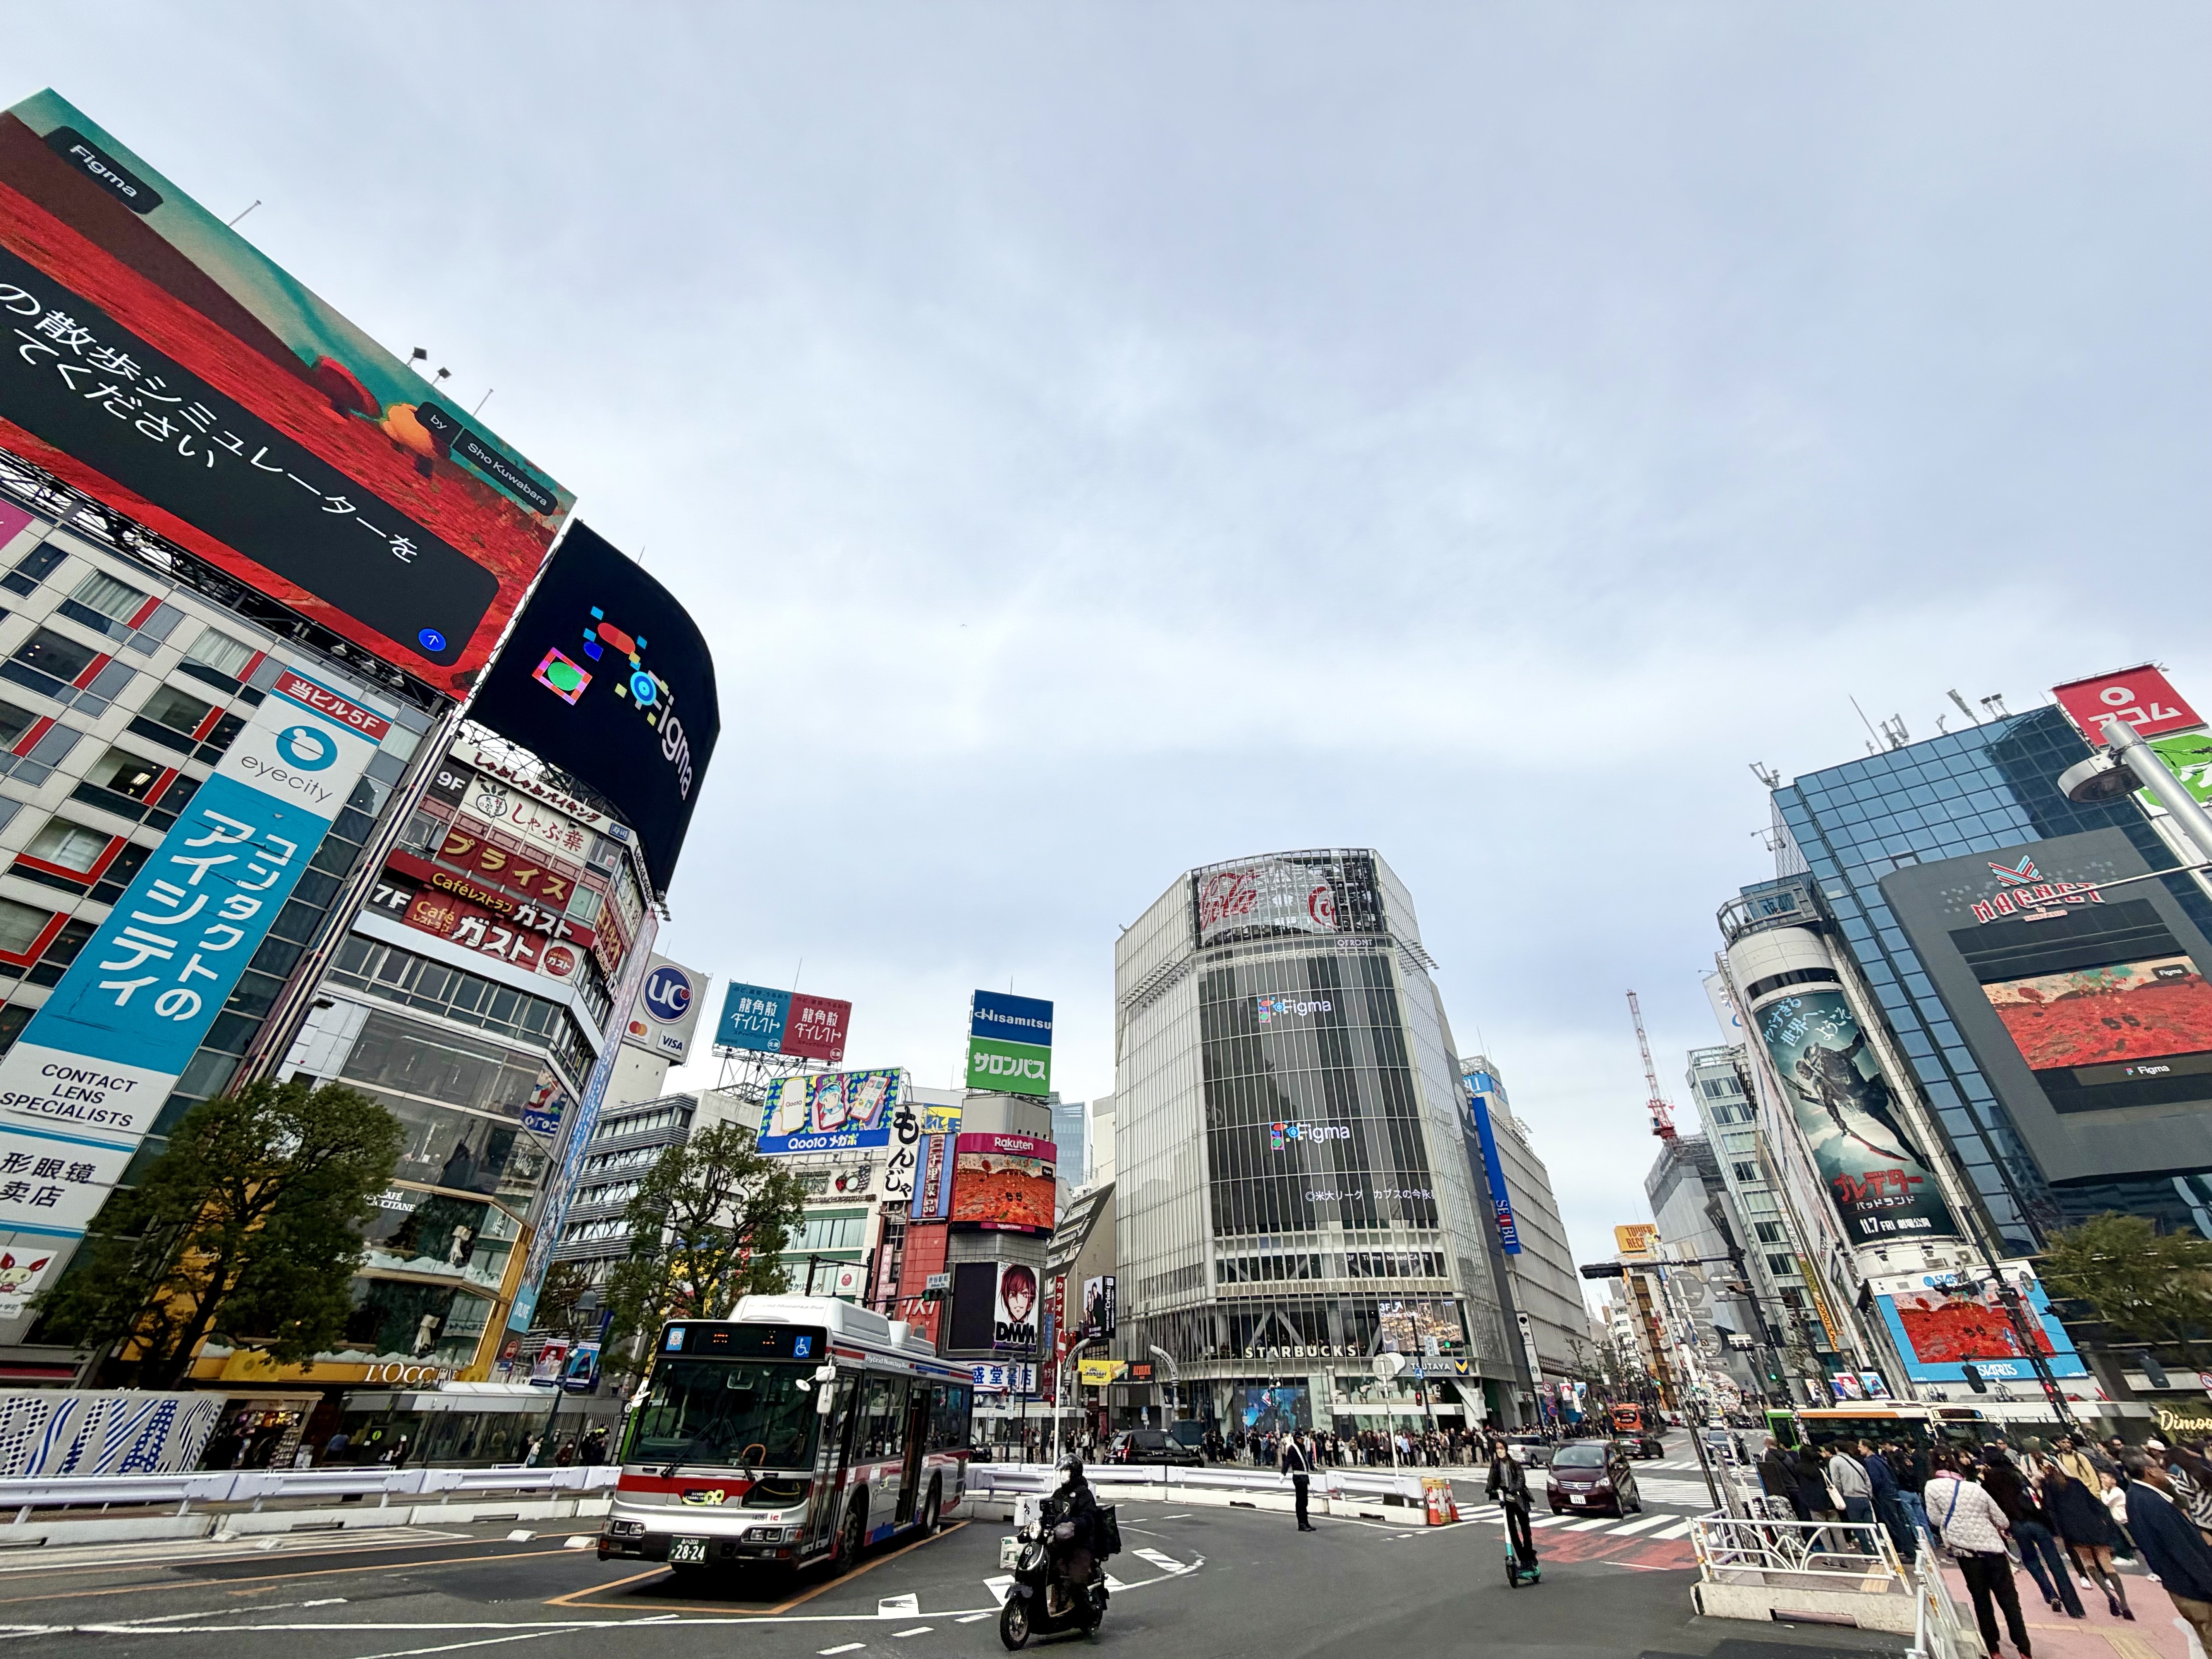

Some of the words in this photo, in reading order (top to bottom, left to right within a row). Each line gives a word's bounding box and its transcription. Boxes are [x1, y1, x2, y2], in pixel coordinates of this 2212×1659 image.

[70, 144, 137, 197] Figma
[14, 328, 214, 467] てください
[0, 283, 418, 563] の散歩シミュレーターを
[429, 414, 447, 430] by
[467, 442, 493, 465] Sho
[492, 461, 547, 507] Kuwabara
[288, 680, 380, 730] 当ビル5F
[2088, 702, 2183, 731] アコム
[242, 756, 333, 803] eyecity
[436, 771, 466, 791] 9F
[474, 751, 602, 823] しゃぶしゃぶバイキング
[511, 803, 584, 852] しゃぶ葉
[445, 832, 569, 902] プライス
[372, 883, 412, 908] 7F
[1971, 883, 2106, 924] MAGNET
[99, 809, 256, 1006] アイシティ
[416, 901, 455, 925] Café
[155, 834, 298, 1021] コンタクトの
[412, 914, 450, 932] レストラン
[512, 903, 573, 939] ガスト
[451, 916, 534, 961] ガスト
[1337, 939, 1372, 947] QFRONT
[547, 956, 571, 970] ガスト
[2159, 967, 2183, 976] Figma
[739, 997, 778, 1017] 龍角散
[802, 1007, 839, 1027] 龍角散
[1283, 999, 1331, 1017] Figma
[731, 1013, 781, 1034] ダイレクト
[974, 1008, 1051, 1030] Hisamitsu
[1763, 998, 1802, 1042] ヤバすぎる
[662, 1035, 683, 1051] VISA
[795, 1023, 842, 1043] ダイレクト
[974, 1052, 1046, 1080] サロンパス
[2137, 1064, 2170, 1076] Figma
[41, 1064, 139, 1093] CONTACT
[52, 1084, 105, 1104] LENS
[0, 1092, 133, 1127] SPECIALISTS
[788, 1137, 826, 1149] Qoo10
[829, 1133, 860, 1148] メガポ
[994, 1137, 1034, 1151] Rakuten
[1296, 1123, 1350, 1144] Figma
[885, 1105, 919, 1198] もんじゃ
[1834, 1169, 1923, 1202] プレデター
[1856, 1195, 1915, 1211] バッドランド
[1496, 1200, 1517, 1244] SEIBU
[1625, 1226, 1654, 1237] TOWER
[1860, 1217, 1879, 1234] 11.7
[1879, 1220, 1896, 1231] FRI
[1379, 1303, 1390, 1312] 3F
[1817, 1302, 1831, 1328] TOUCH
[865, 1355, 883, 1365] Hybrid
[1245, 1345, 1357, 1358] STARBUCKS
[1976, 1364, 2017, 1376] STARTS
[2158, 1410, 2212, 1431] Dimoo
